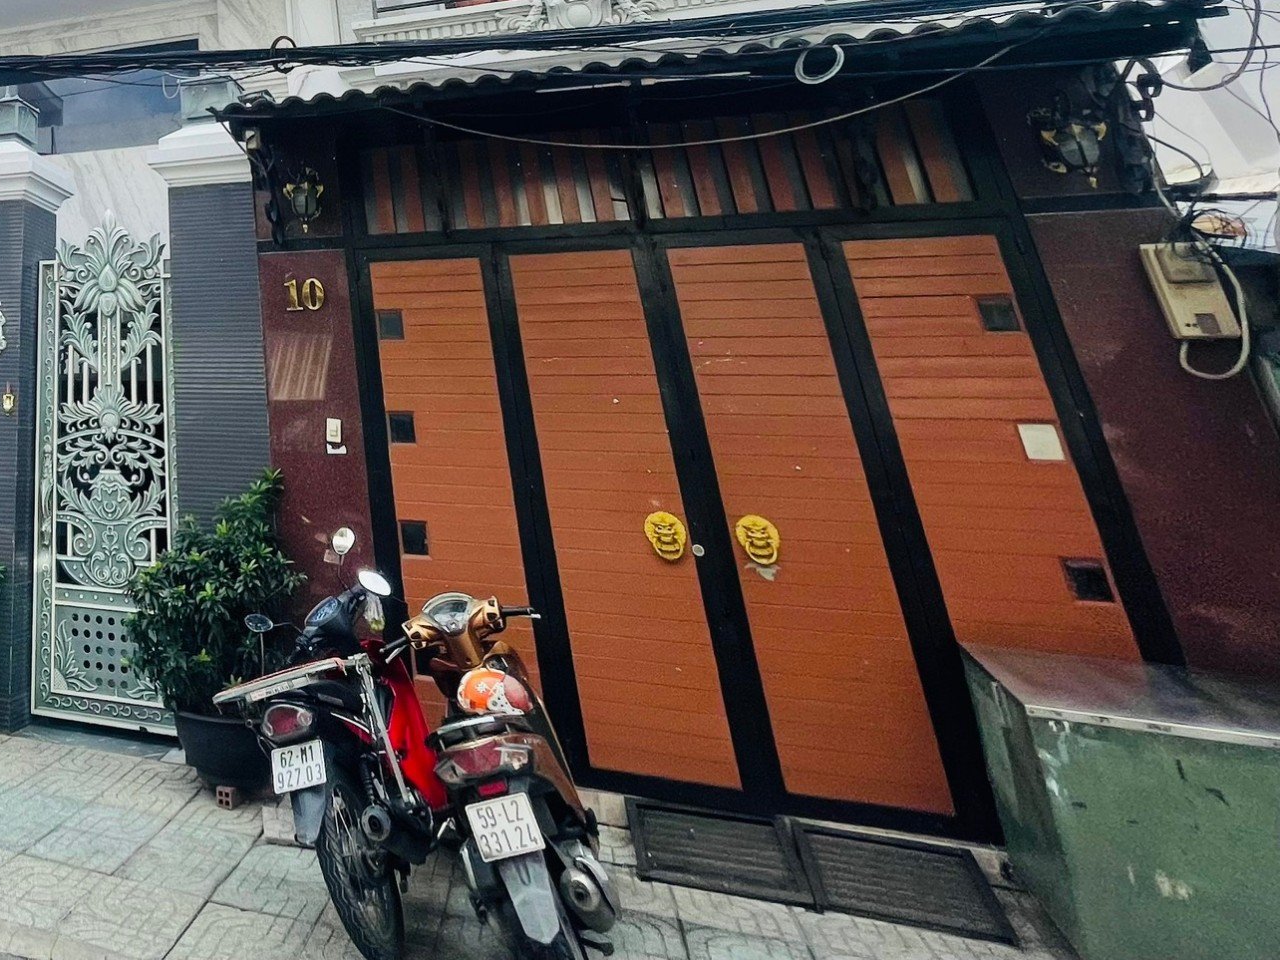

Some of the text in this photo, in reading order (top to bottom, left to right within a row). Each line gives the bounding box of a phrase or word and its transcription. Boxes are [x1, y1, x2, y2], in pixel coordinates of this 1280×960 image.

[283, 277, 325, 311] 10
[277, 763, 323, 789] 927.03
[476, 799, 524, 829] 59-L2
[479, 823, 538, 855] 331.24
